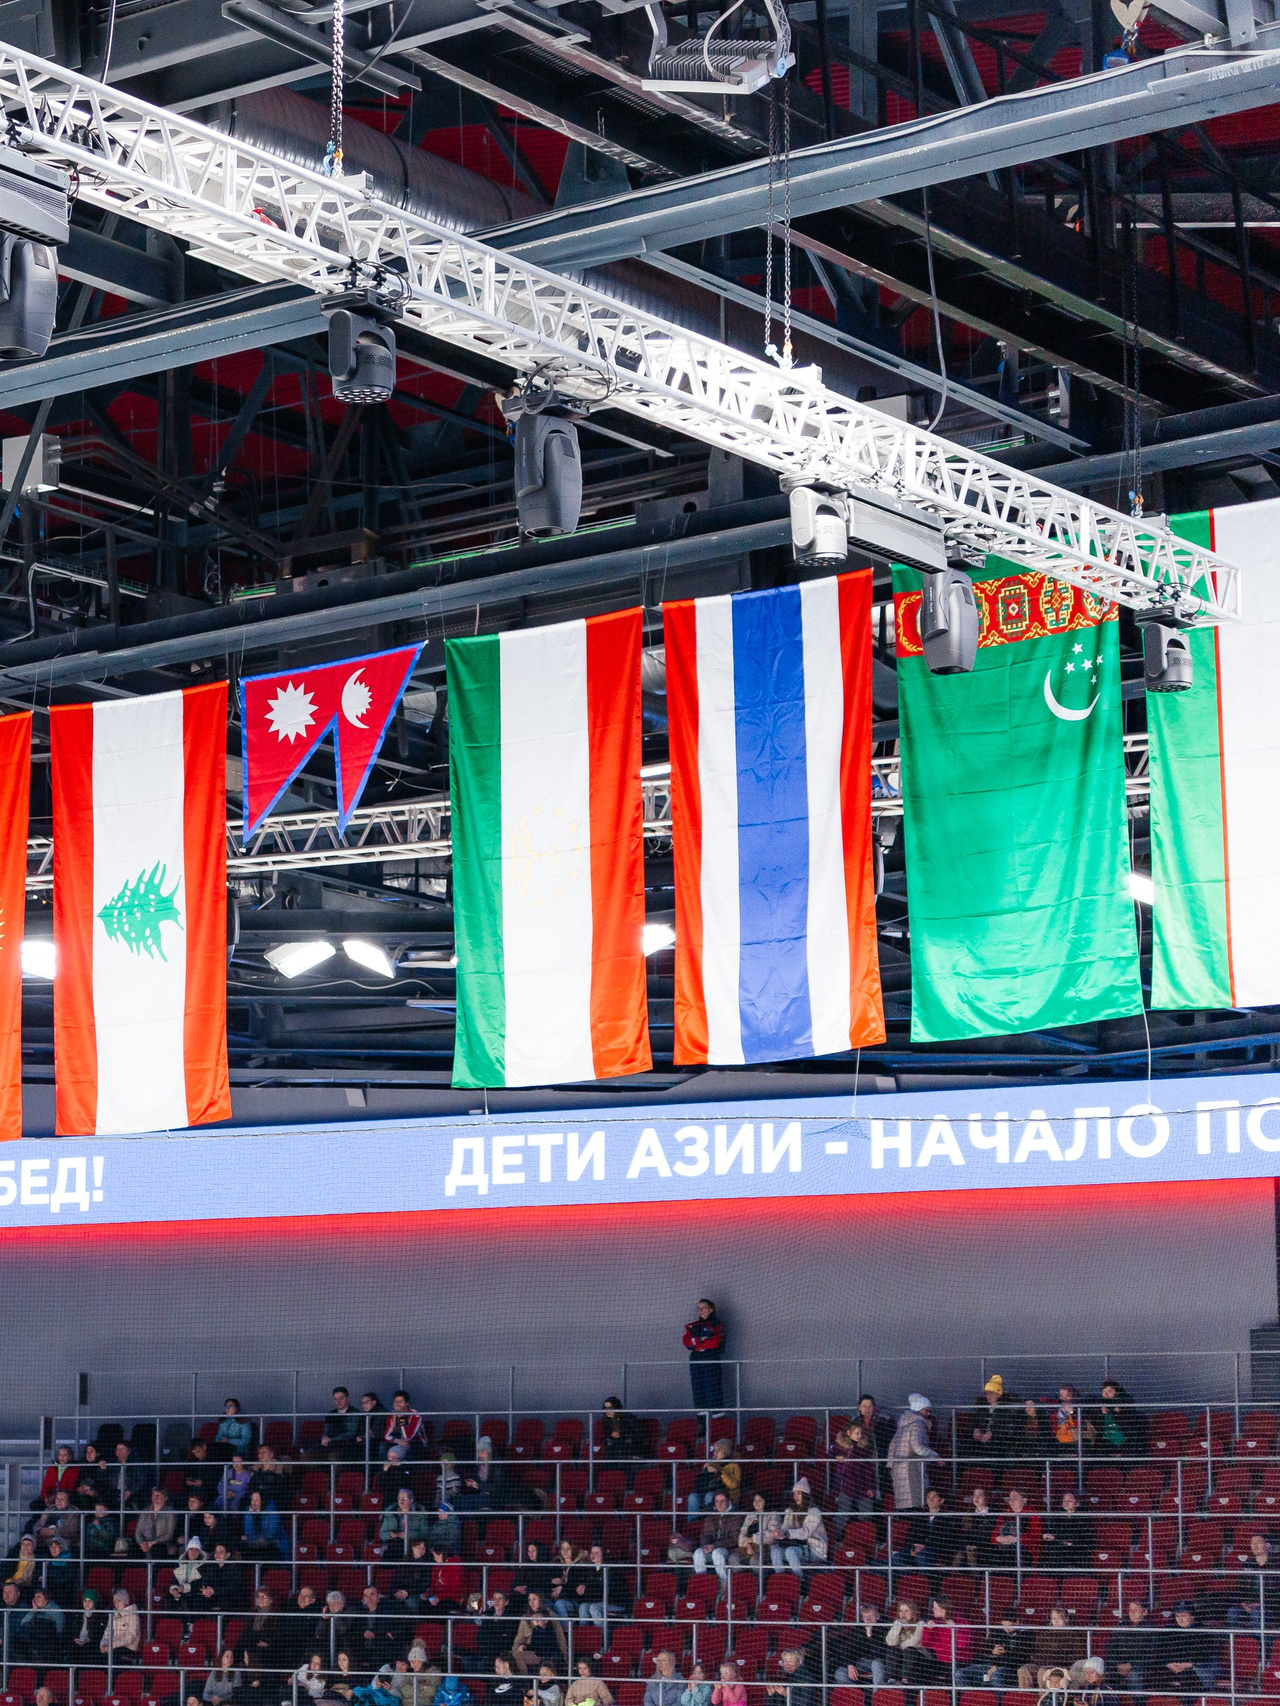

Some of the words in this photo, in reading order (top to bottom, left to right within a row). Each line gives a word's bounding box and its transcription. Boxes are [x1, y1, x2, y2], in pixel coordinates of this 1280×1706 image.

[445, 1131, 606, 1197] ДЕТИ
[627, 1121, 802, 1179] АЗИИ
[826, 1141, 848, 1155] -
[871, 1104, 1170, 1169] НАЧАЛО
